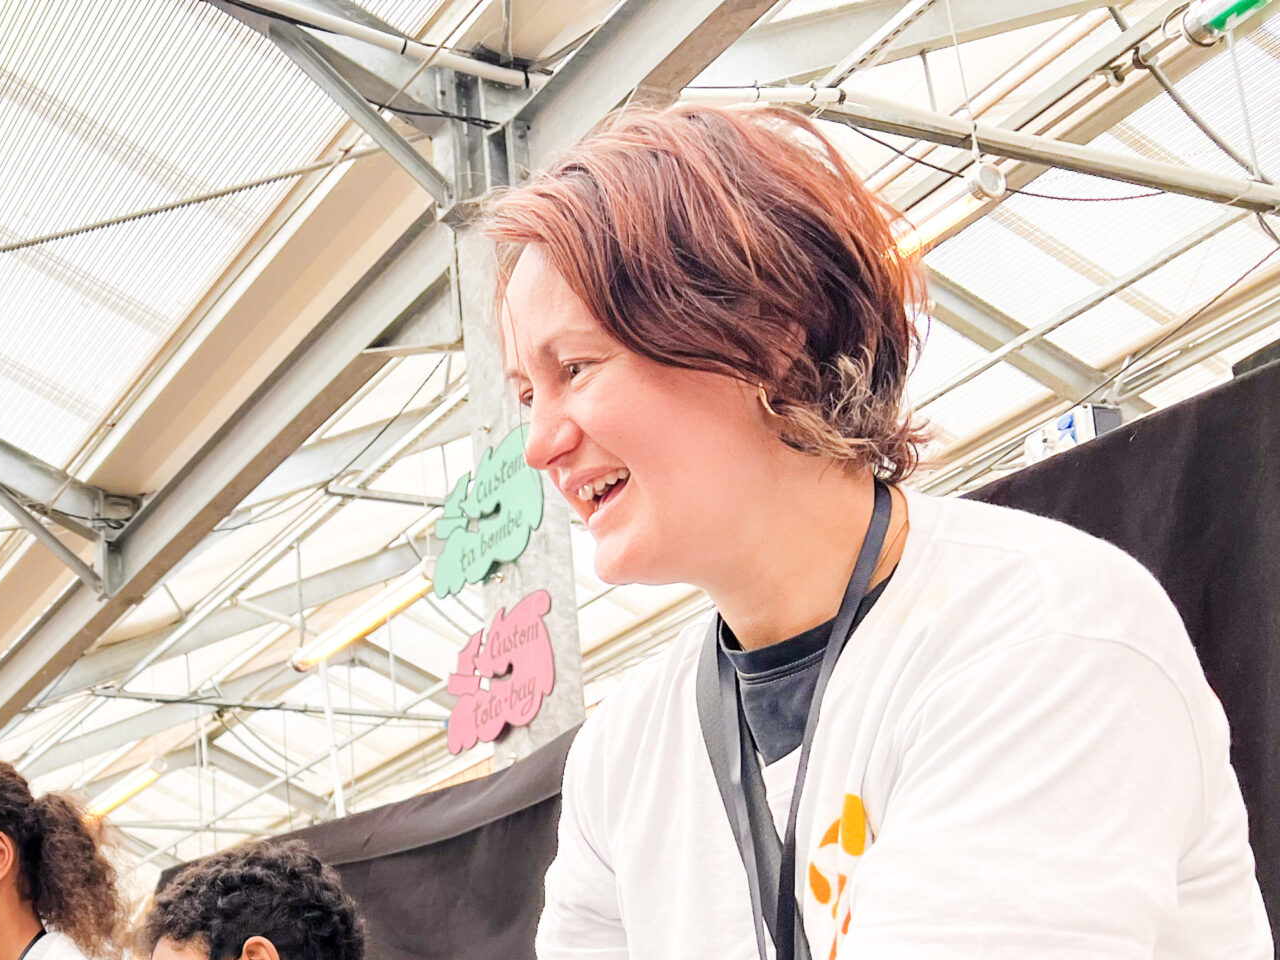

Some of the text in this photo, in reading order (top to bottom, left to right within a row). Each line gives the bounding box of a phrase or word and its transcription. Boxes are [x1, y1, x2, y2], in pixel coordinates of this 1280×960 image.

[476, 454, 526, 503] Custom
[460, 510, 522, 573] ta bombe
[490, 621, 539, 660] Custom
[473, 676, 536, 729] tote-bag
